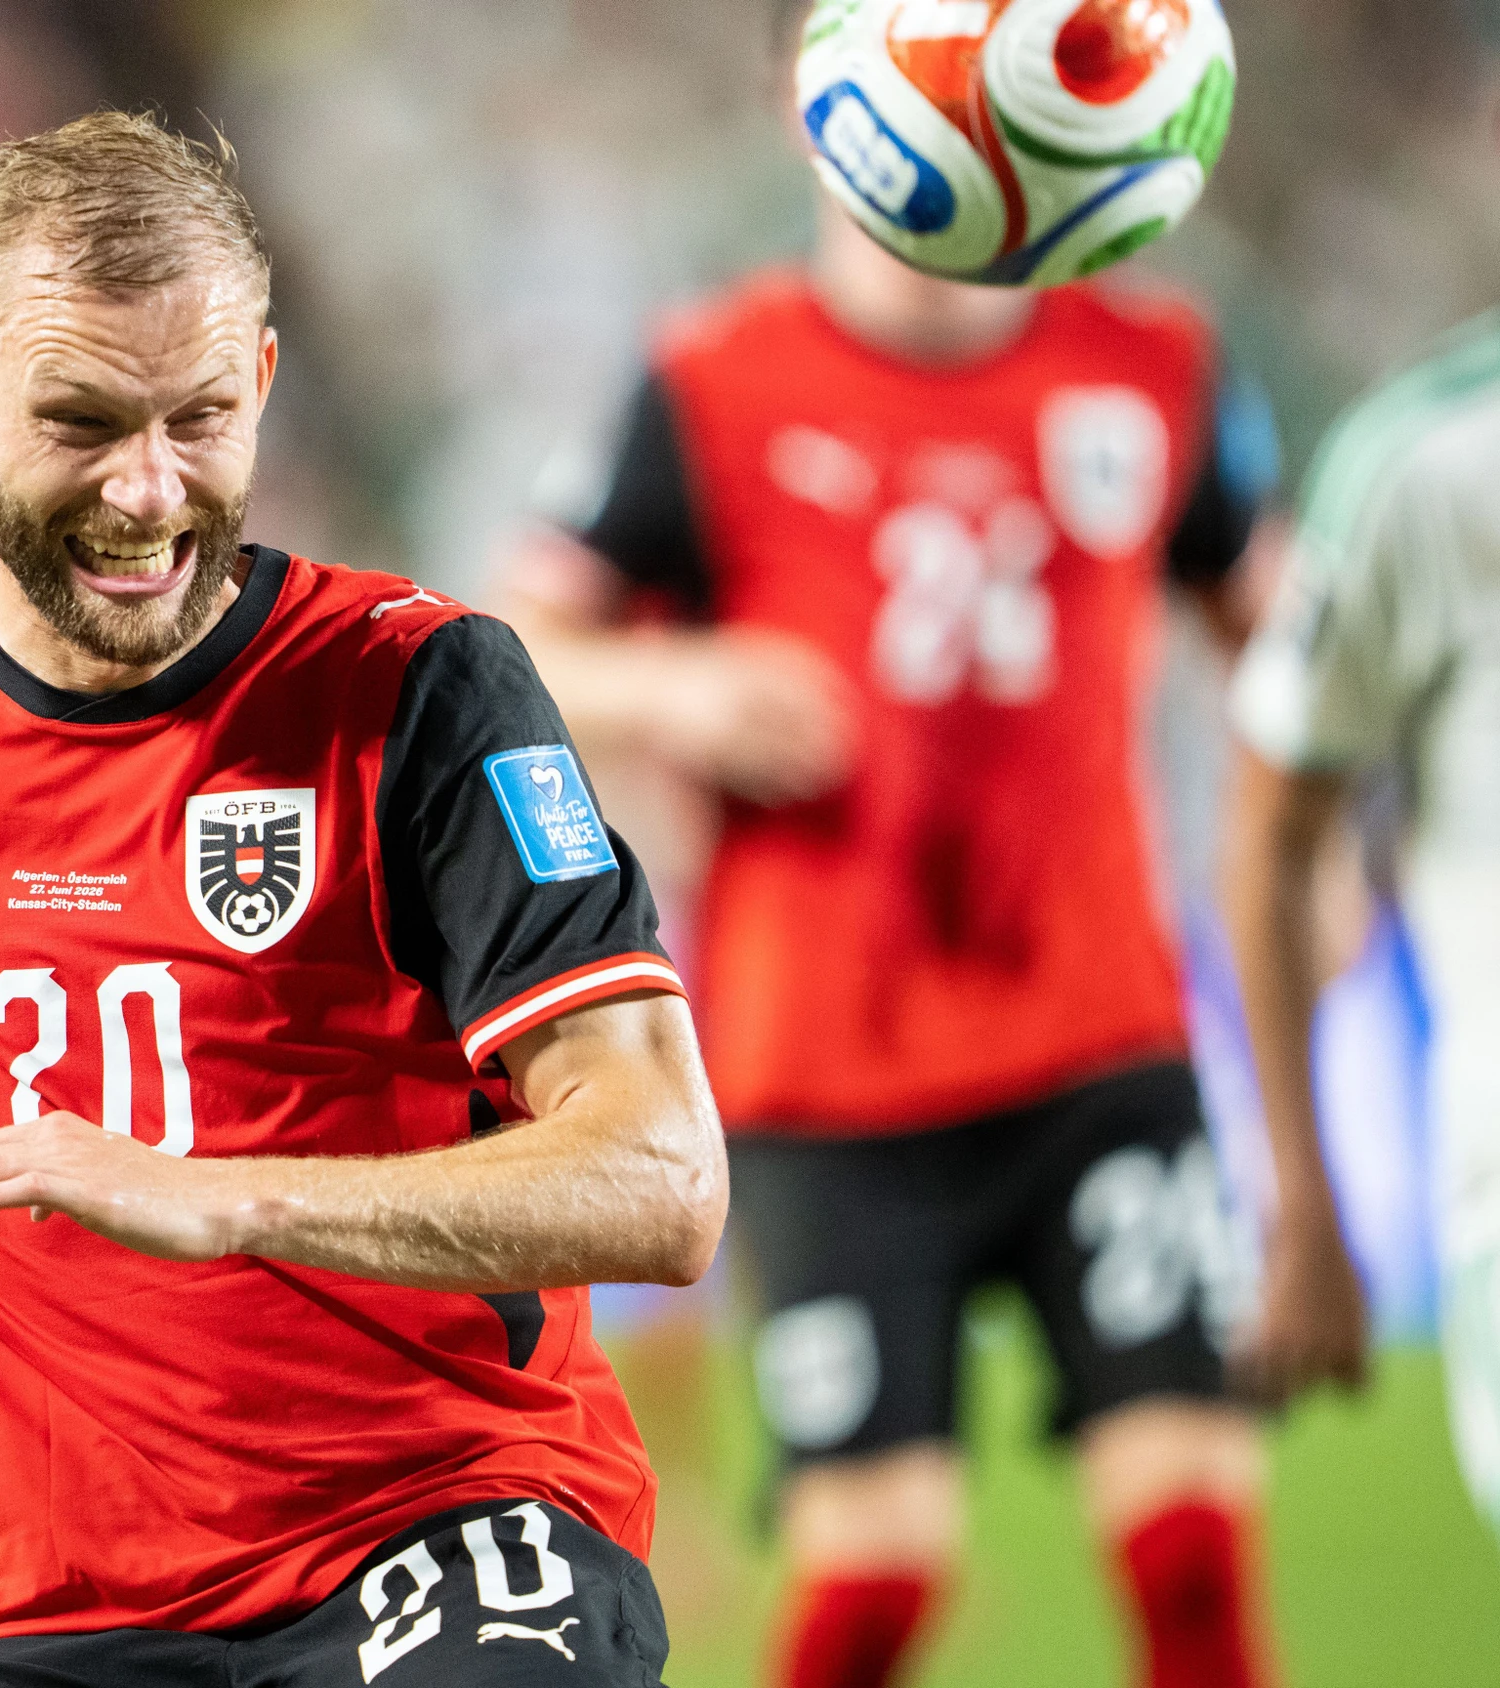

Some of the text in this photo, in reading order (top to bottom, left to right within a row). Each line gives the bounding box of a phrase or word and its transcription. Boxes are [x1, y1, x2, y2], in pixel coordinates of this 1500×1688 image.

[224, 801, 276, 817] ÖFB
[534, 799, 589, 829] Unite For
[545, 821, 599, 850] PEACE
[564, 848, 594, 862] FIFA
[11, 869, 60, 883] Algerien
[67, 870, 128, 885] Österreich
[29, 884, 104, 897] 27. Juni 2026
[7, 897, 122, 912] Kansas-City-Stadion
[357, 1501, 575, 1686] 20
